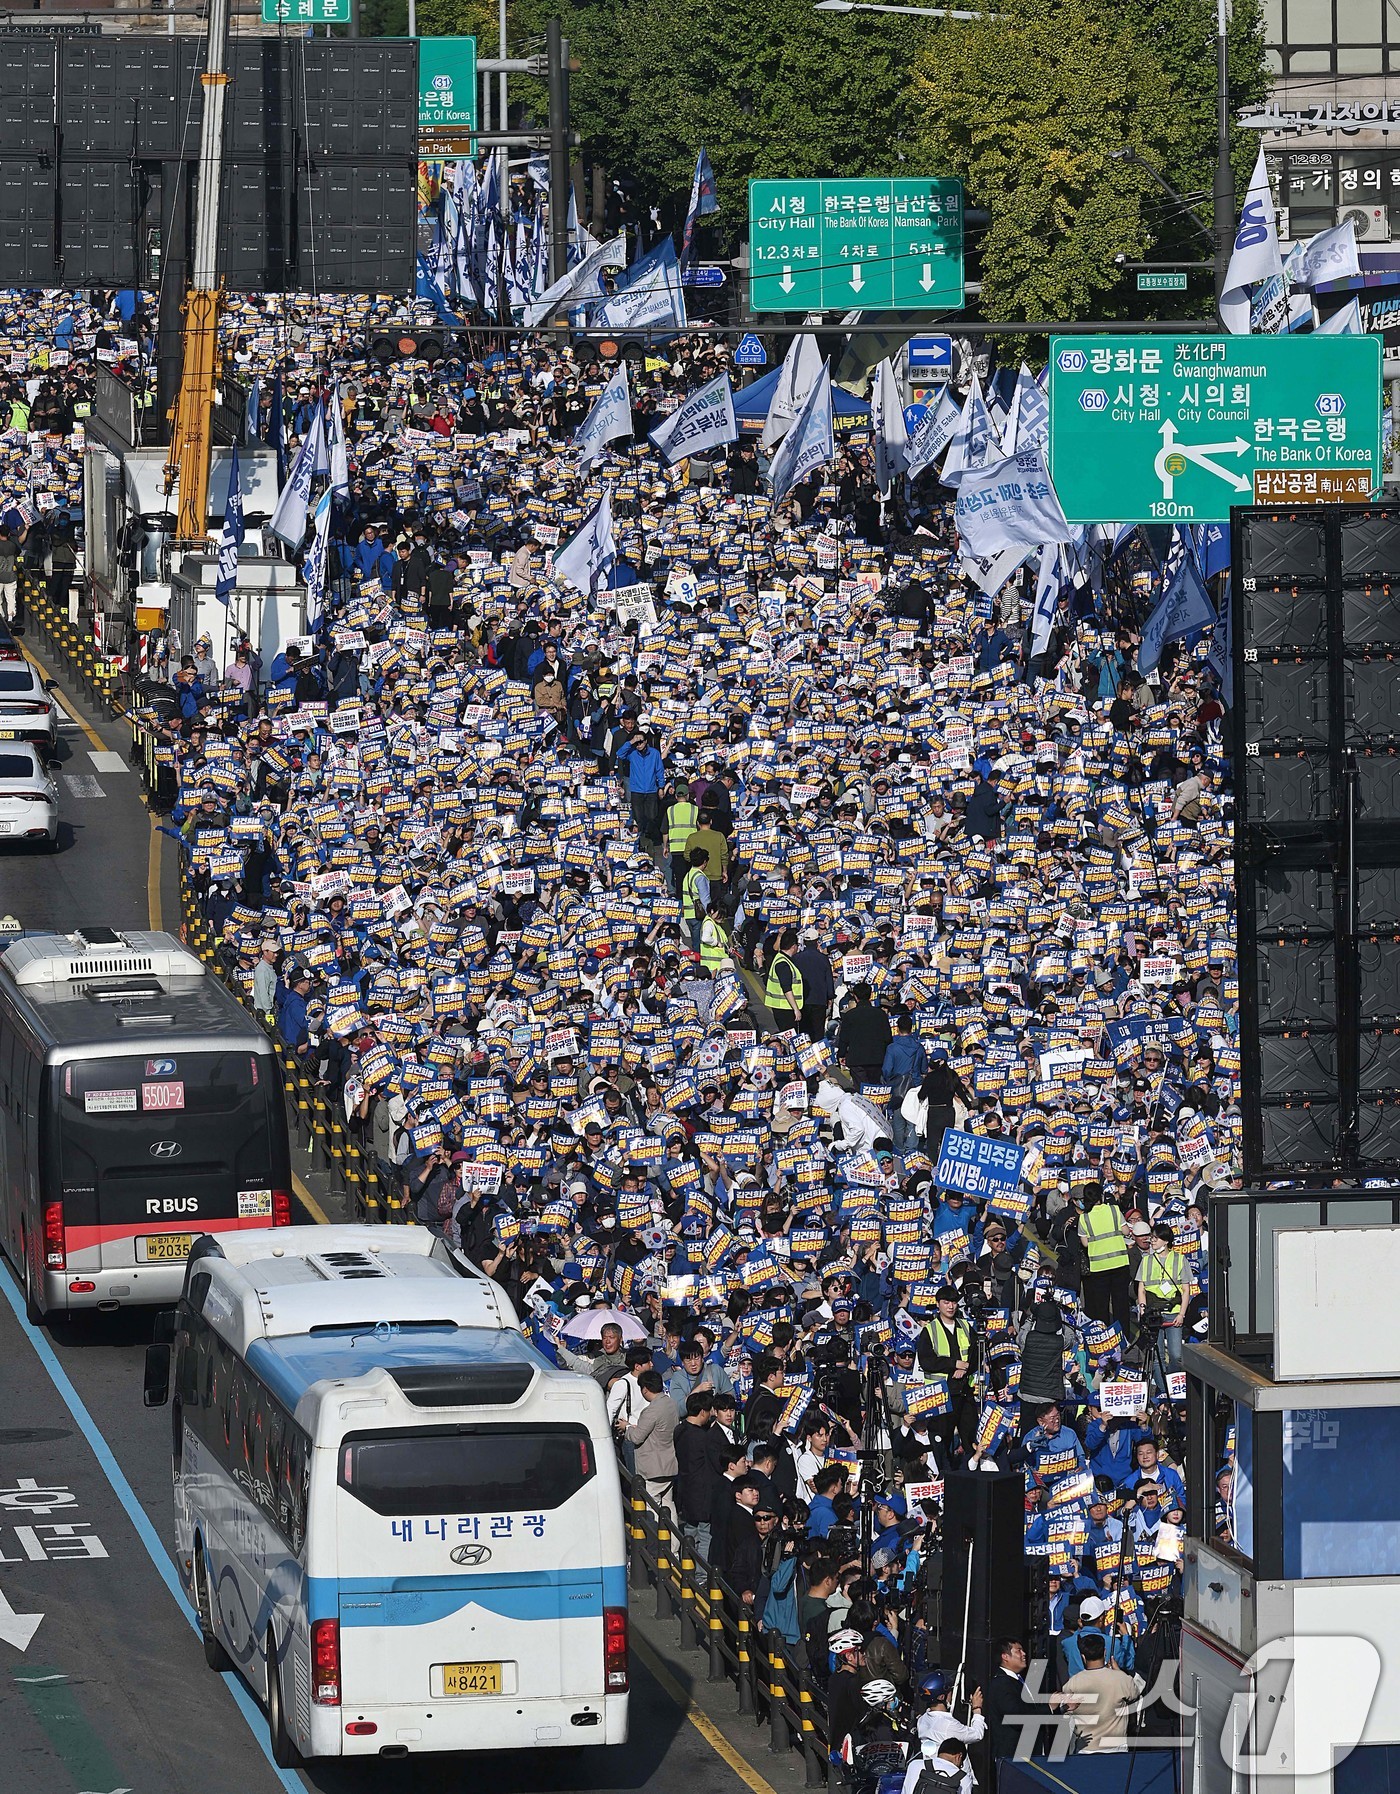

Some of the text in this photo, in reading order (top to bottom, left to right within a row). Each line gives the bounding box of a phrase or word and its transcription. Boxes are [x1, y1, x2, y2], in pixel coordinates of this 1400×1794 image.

[275, 0, 338, 17] 숭례문
[436, 78, 448, 88] 31
[419, 91, 454, 107] 은행
[434, 110, 444, 120] Of
[446, 110, 470, 120] Korea
[433, 144, 453, 154] Park
[1289, 154, 1332, 165] 1232
[770, 196, 806, 214] 시청
[824, 195, 890, 214] 한국은행
[895, 195, 959, 214] 남산공원
[758, 217, 815, 232] City Hall
[825, 217, 889, 228] The Bank Of Korea
[895, 217, 959, 228] Namsan Park
[909, 243, 946, 256] 5차로
[1175, 344, 1226, 361] 光化門
[1063, 354, 1081, 369] 50
[1090, 348, 1163, 374] 광화문
[912, 366, 949, 378] 일방통행
[1174, 363, 1267, 381] Gwanghwamun
[1085, 393, 1103, 408] 60
[1320, 398, 1340, 413] 31
[1112, 409, 1160, 423] City Hall
[1178, 408, 1249, 422] City Council
[1255, 418, 1347, 442] 한국은행
[1255, 447, 1372, 461] The Bank Of Korea
[1256, 473, 1317, 494] 남산공원
[1150, 503, 1194, 517] 180m
[505, 872, 531, 880] 국정농단
[505, 879, 533, 888] 진상규명!
[846, 956, 871, 966] 국정농단
[1144, 960, 1173, 969] 국정농단
[1144, 968, 1174, 977] 진상규명!
[421, 1081, 449, 1092] 김건희를
[144, 1086, 183, 1107] 5500-2
[724, 1135, 756, 1144] 김건희를
[948, 1134, 1020, 1171] 강한 민주당
[666, 1161, 695, 1180] 김건희를
[1148, 1173, 1179, 1183] 김건희를
[240, 1193, 257, 1202] 주의
[796, 1189, 828, 1202] 김건희를
[842, 1188, 875, 1199] 김건희를
[994, 1190, 1029, 1203] 김건희를
[798, 1194, 833, 1210] 특검하라!
[841, 1197, 877, 1209] 특검하라!
[889, 1201, 920, 1211] 김건희를
[991, 1198, 1031, 1213] 특검하라!
[886, 1223, 918, 1233] 김건희를
[792, 1231, 825, 1241] 김건희를
[791, 1240, 827, 1251] 특검하라!
[906, 1383, 943, 1404] 김건희를
[1104, 1384, 1143, 1396] 국정농단
[908, 1392, 949, 1414] 특검하라!
[1104, 1394, 1146, 1407] 진상규명!
[1040, 1453, 1075, 1465] 김건희를
[1038, 1458, 1077, 1474] 특검하라!
[1052, 1473, 1089, 1496] 김건희를
[1048, 1521, 1086, 1536] 김건희를
